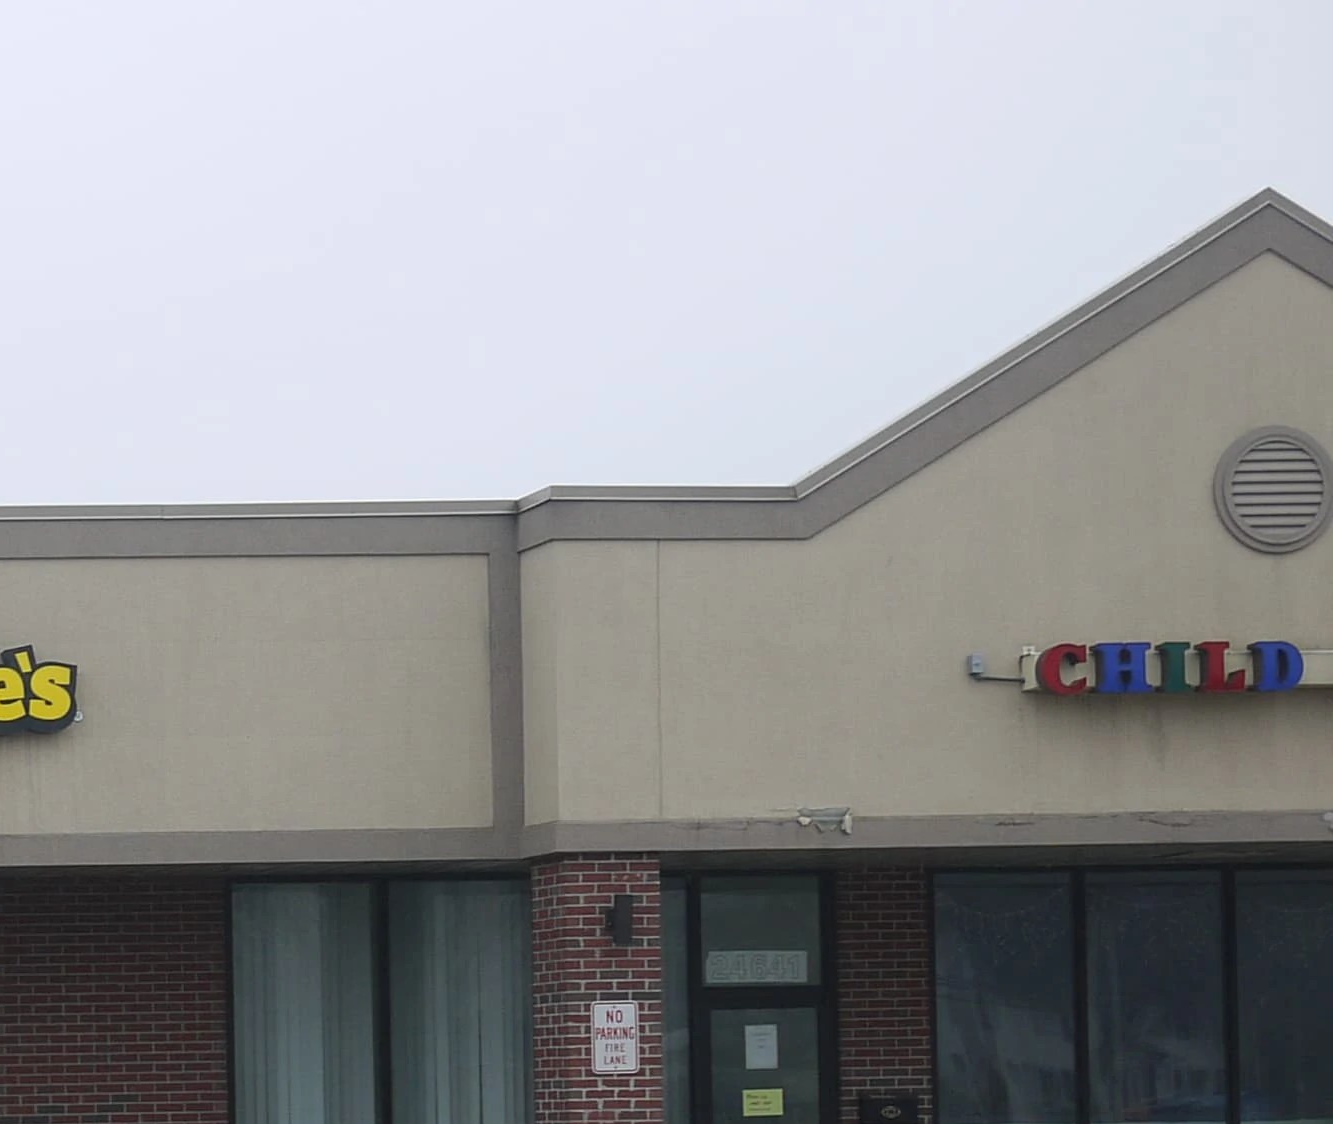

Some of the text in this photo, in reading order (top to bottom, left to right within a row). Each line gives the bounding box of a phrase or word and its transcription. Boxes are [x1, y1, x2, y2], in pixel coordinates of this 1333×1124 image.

[1037, 640, 1305, 695] CHILD
[710, 953, 801, 981] 24641
[605, 1009, 624, 1024] NO
[595, 1026, 635, 1040] PARKING
[604, 1043, 626, 1053] FIRE
[603, 1055, 628, 1065] LANE
